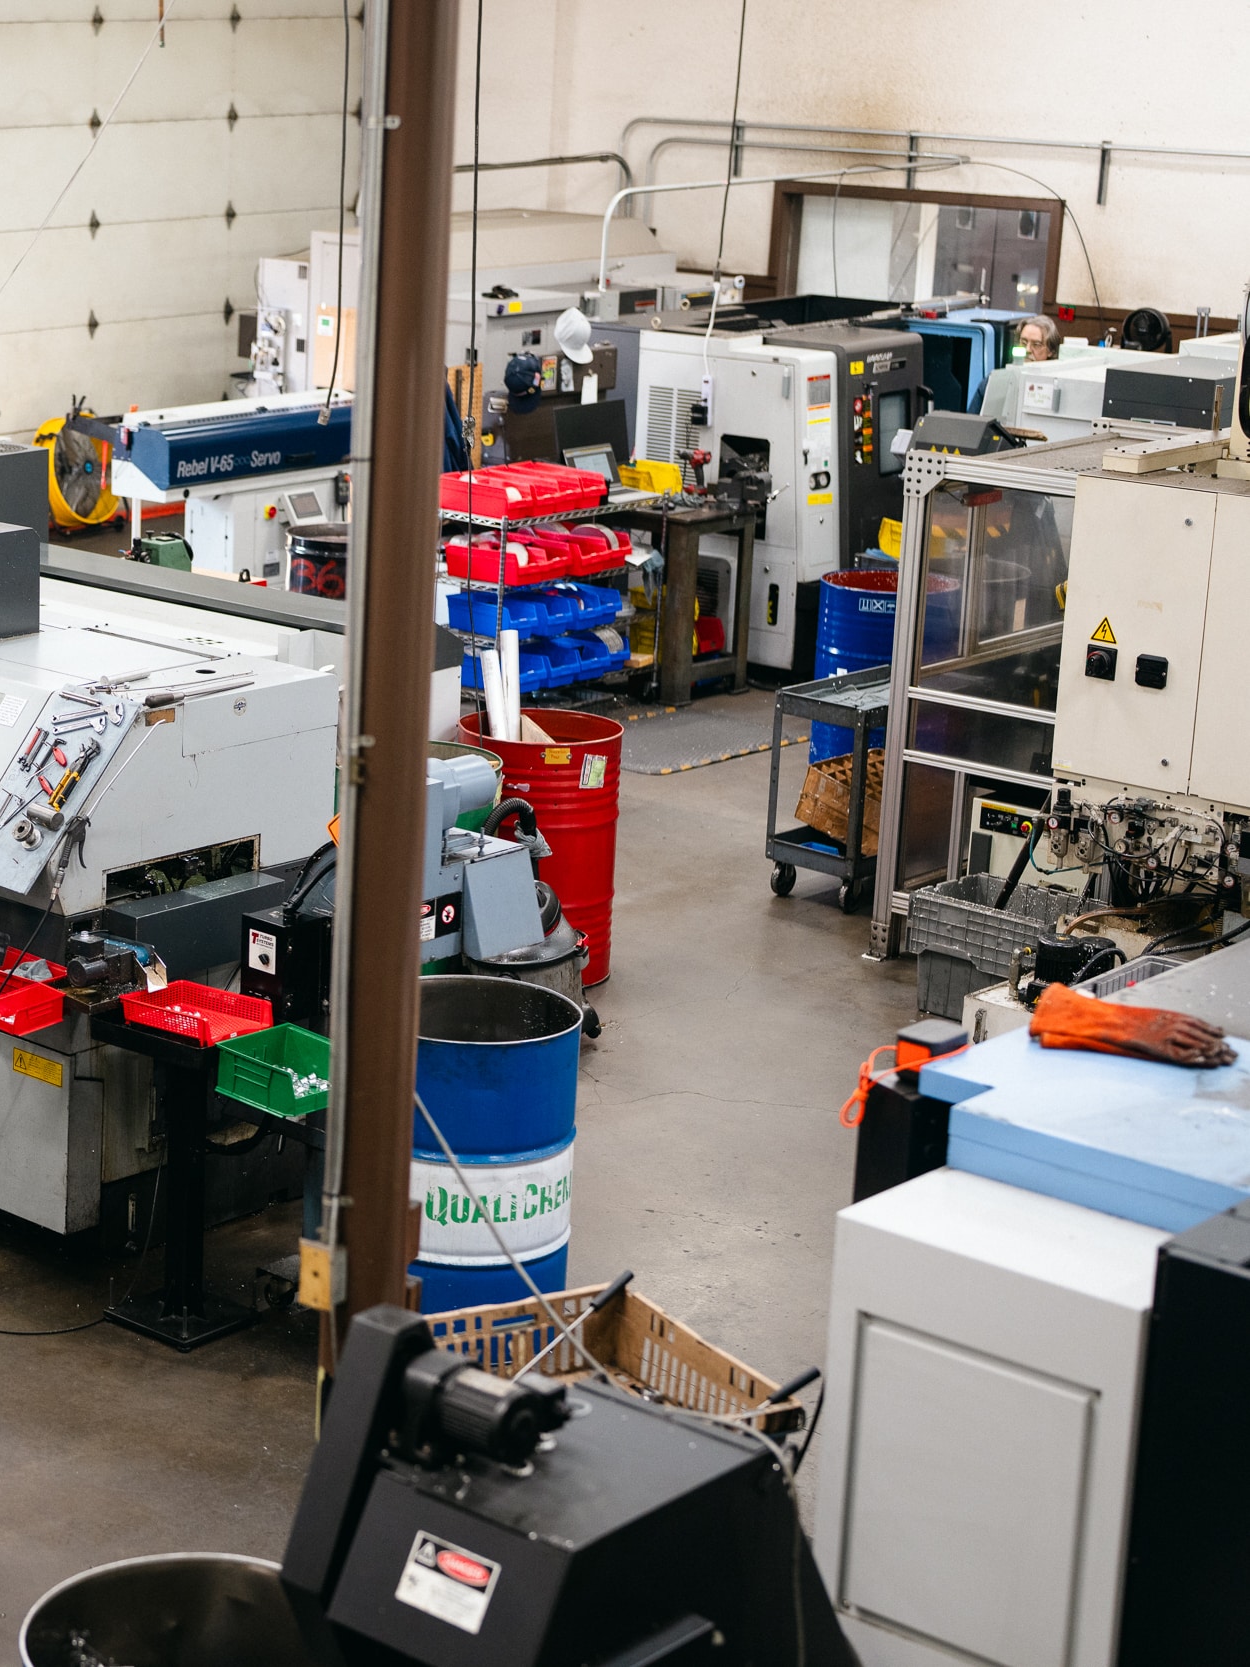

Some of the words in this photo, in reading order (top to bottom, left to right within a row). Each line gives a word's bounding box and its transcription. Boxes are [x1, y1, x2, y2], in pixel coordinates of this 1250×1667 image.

[177, 457, 209, 478] Rebel
[210, 454, 235, 473] V-65
[250, 450, 282, 468] Servo
